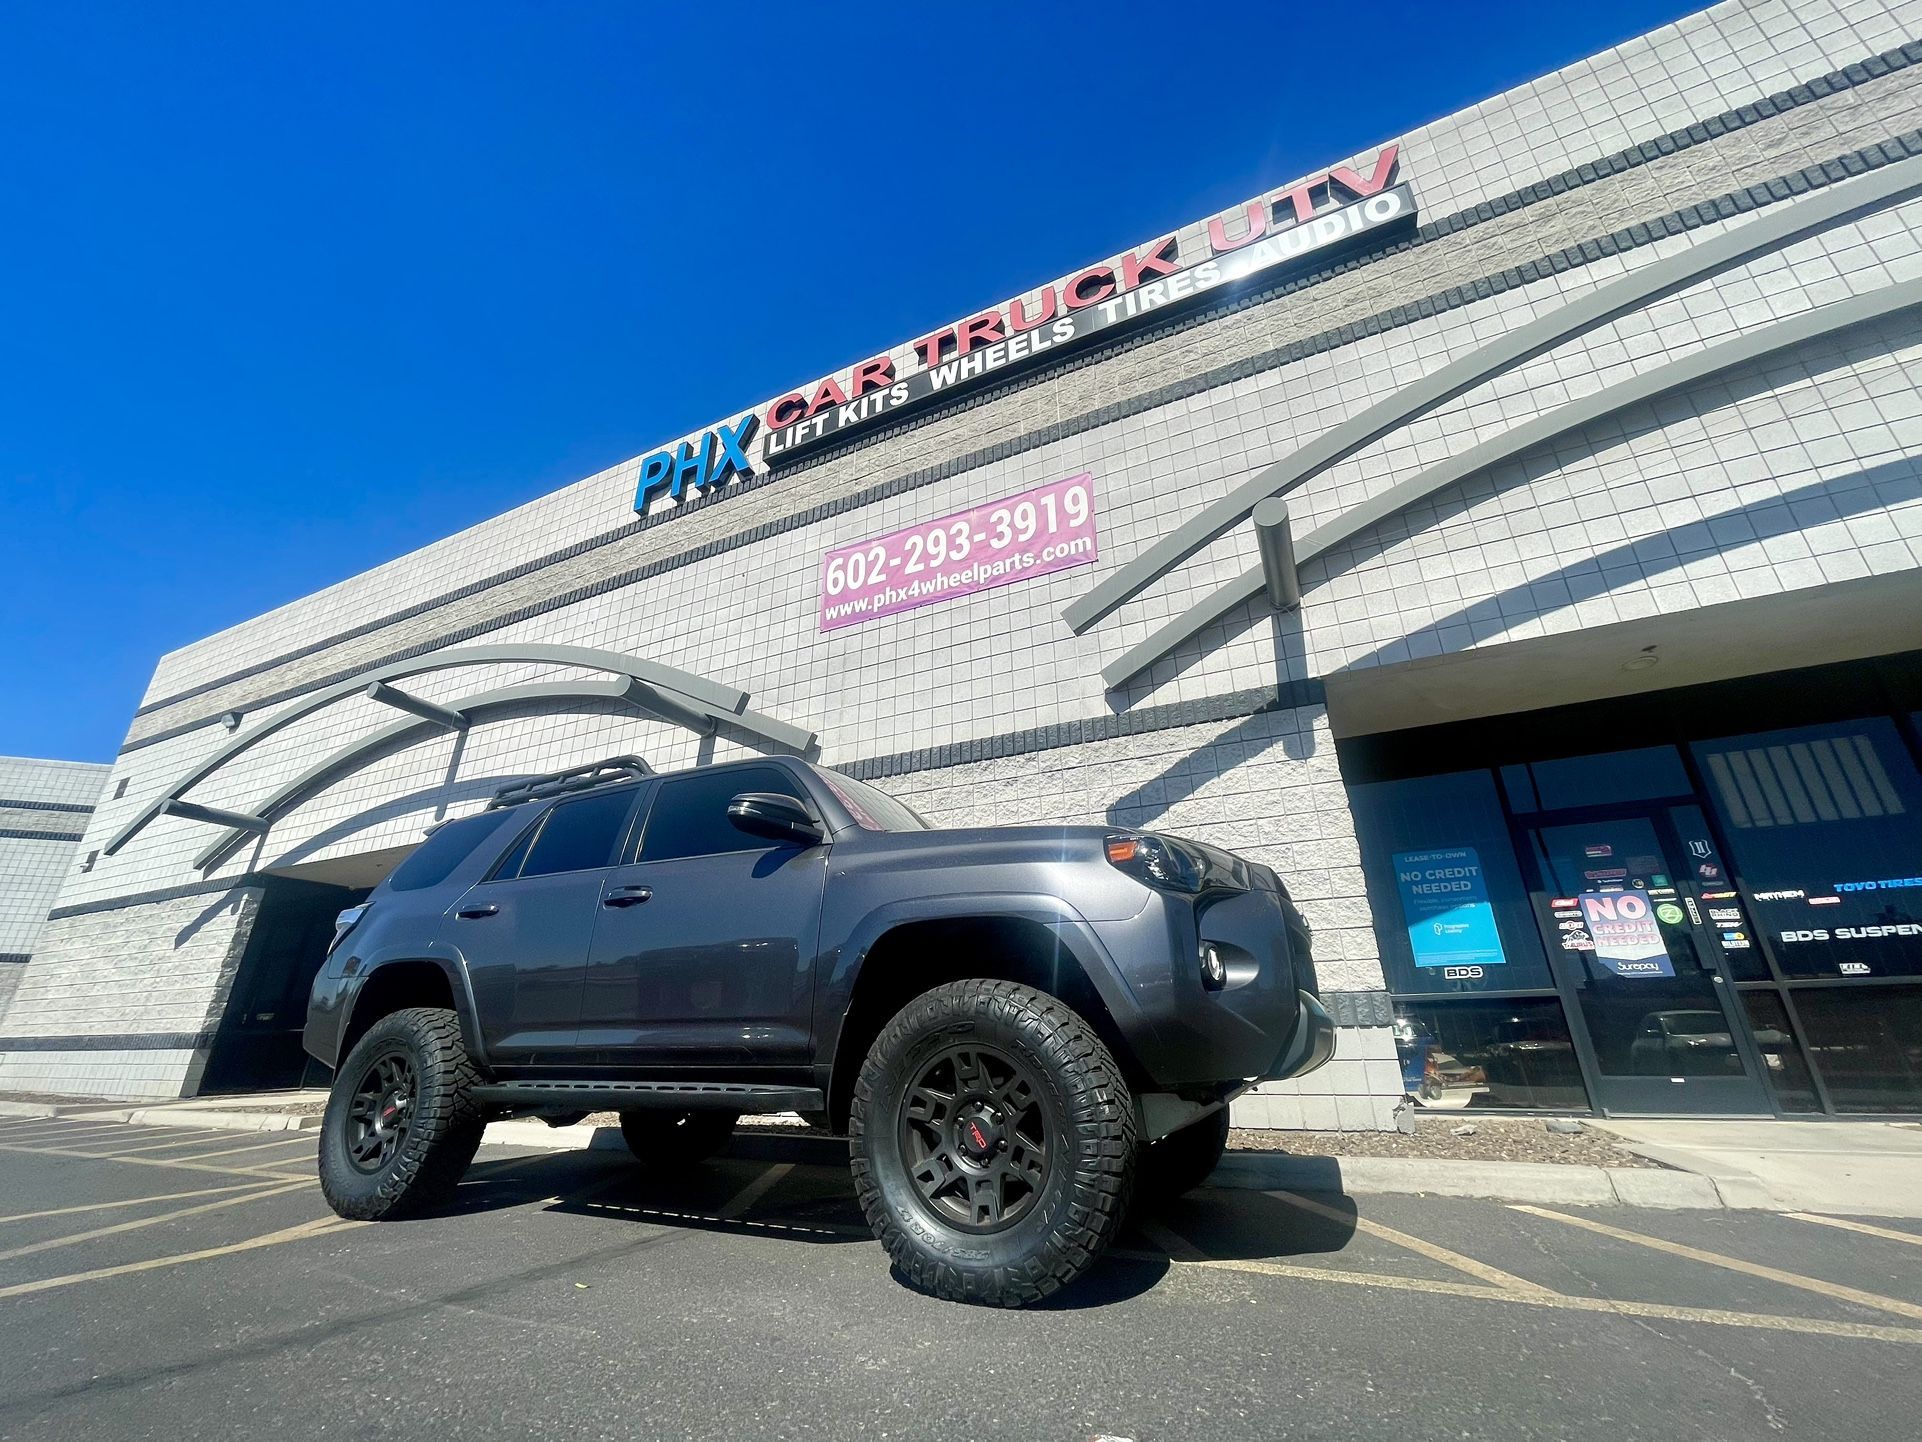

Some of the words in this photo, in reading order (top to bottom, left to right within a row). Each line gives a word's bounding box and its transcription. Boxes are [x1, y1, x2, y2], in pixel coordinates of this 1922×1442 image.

[633, 413, 758, 514] PHX
[766, 356, 895, 430] CAR
[914, 236, 1182, 369] TRUCK
[1207, 144, 1400, 252] UTV
[769, 412, 831, 455] LIFT
[838, 382, 910, 428] KITS
[929, 316, 1076, 391] WHEELS
[1098, 260, 1222, 324] TIRES
[1248, 191, 1401, 268] AUDIO
[826, 485, 1090, 596] 602-293-3919
[825, 536, 1093, 621] www.phx4wheelparts.com
[1400, 871, 1422, 883] NO
[1426, 866, 1479, 880] CREDIT
[1411, 881, 1472, 895] NEEDED
[1834, 881, 1877, 893] TOYO
[1878, 877, 1922, 888] TIRES
[1585, 895, 1647, 922] NO
[1592, 920, 1654, 935] CREDIT
[1780, 929, 1830, 943] BDS
[1834, 923, 1922, 940] SUSPEN
[1597, 933, 1661, 947] NEEDED
[1446, 966, 1483, 978] BDS
[970, 1121, 987, 1149] TRD
